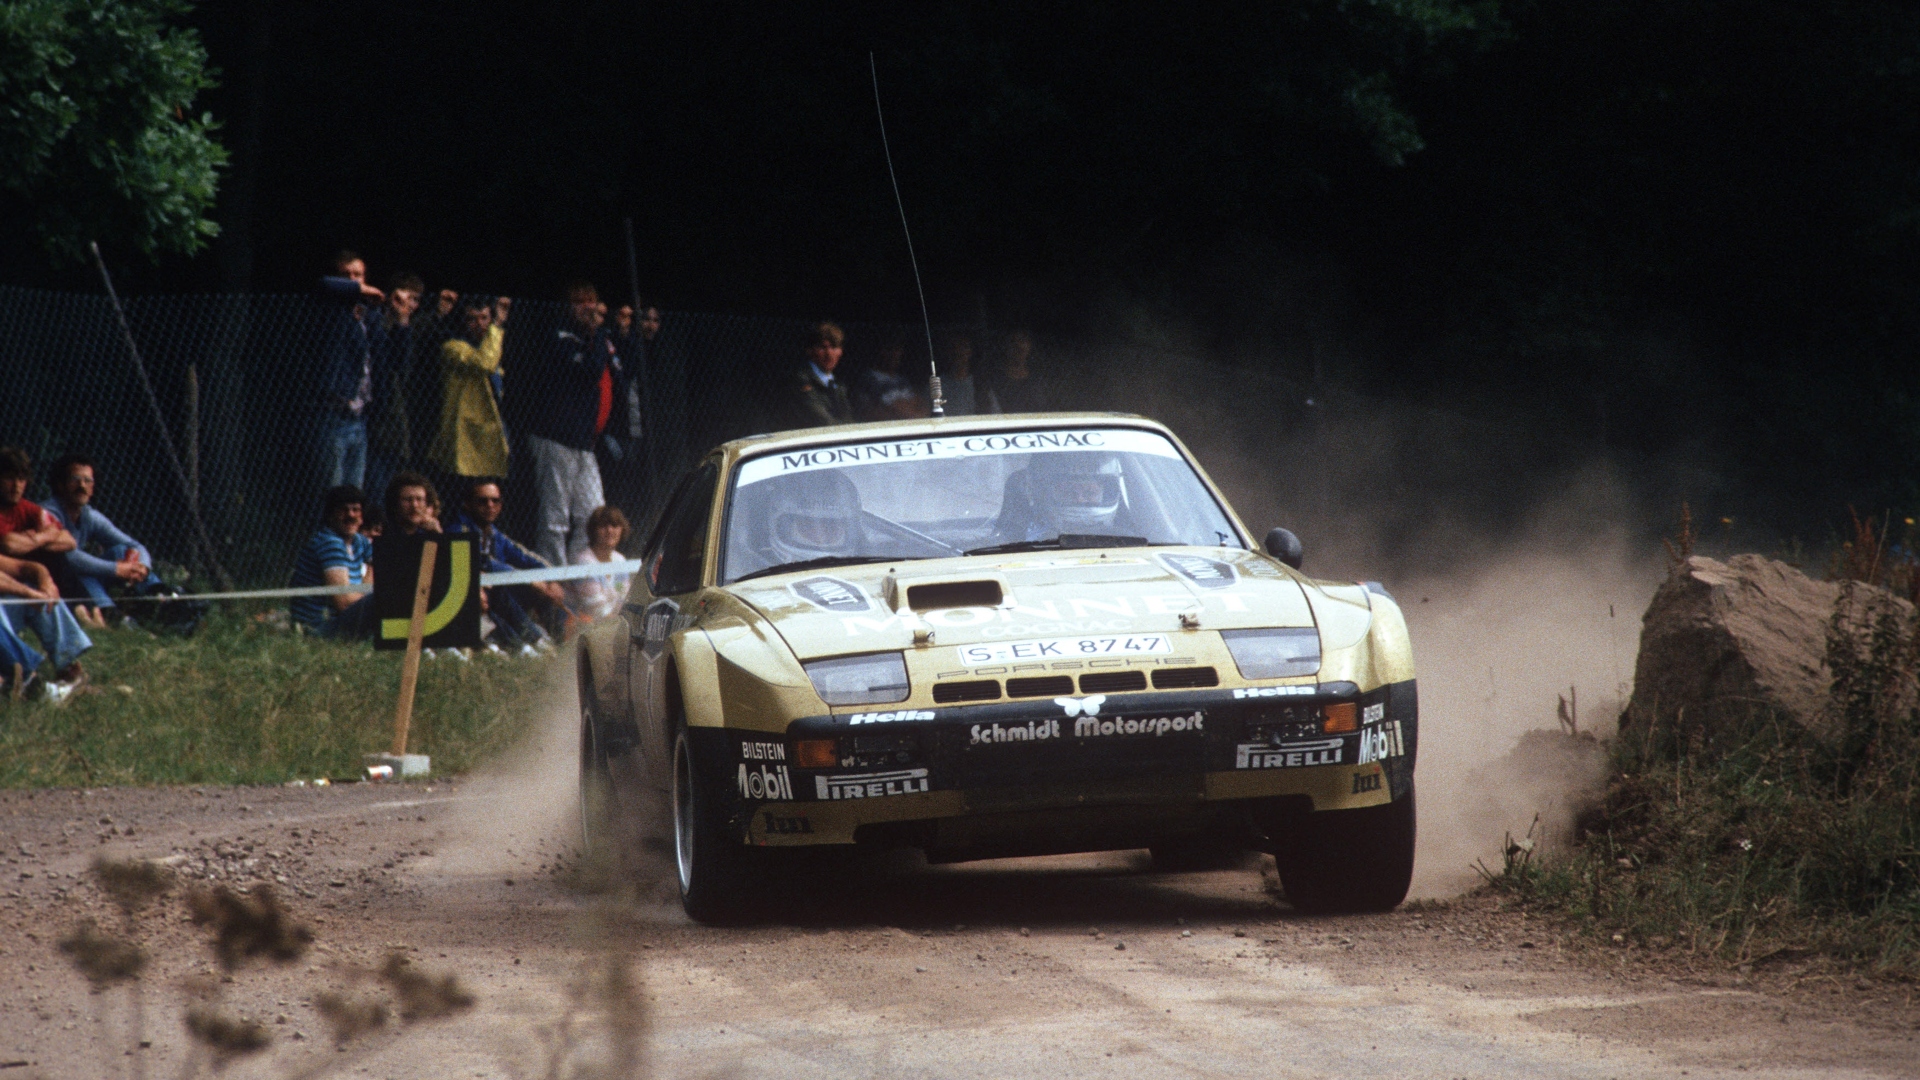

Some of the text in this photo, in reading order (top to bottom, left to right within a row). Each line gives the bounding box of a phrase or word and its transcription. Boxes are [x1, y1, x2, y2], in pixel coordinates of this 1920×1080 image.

[842, 593, 1258, 636] MONNET
[981, 619, 1132, 637] COGNAC
[1078, 637, 1160, 653] 8747
[937, 656, 1196, 680] PORSCHE
[1233, 686, 1316, 699] Hella
[850, 710, 936, 725] Hella
[970, 711, 1203, 745] Schmidt Motorsport
[741, 741, 786, 760] BILSTEIN
[1235, 738, 1344, 769] PIRELLI
[1358, 719, 1405, 766] Mobil
[737, 762, 794, 800] Mobil
[814, 767, 929, 800] PIRELLI
